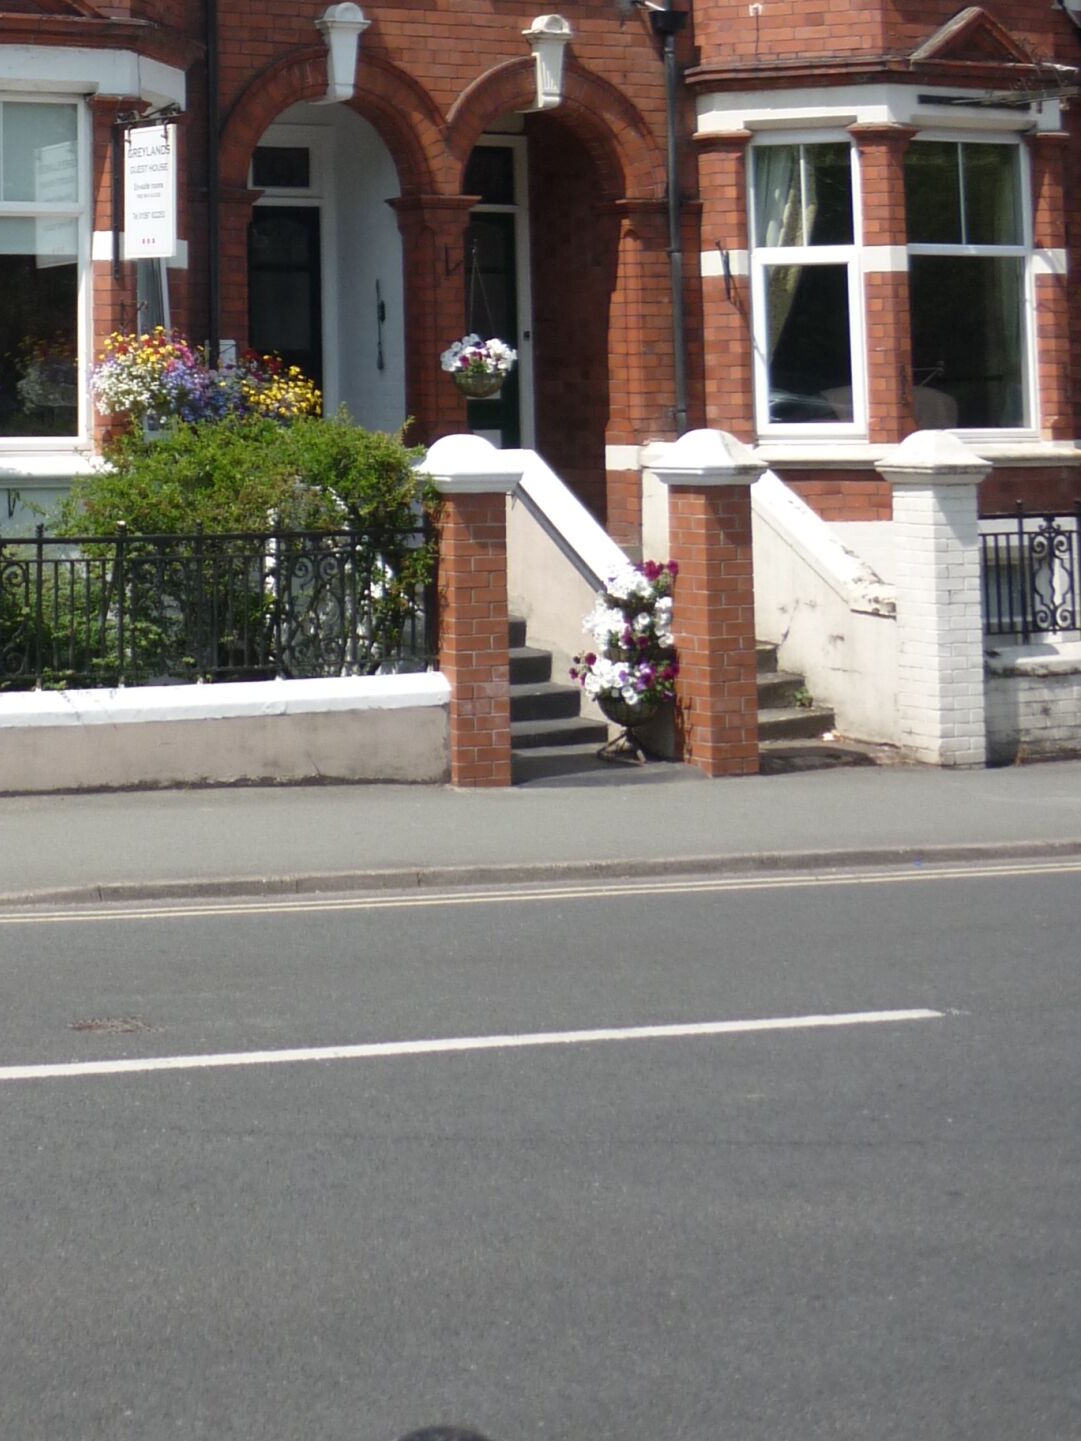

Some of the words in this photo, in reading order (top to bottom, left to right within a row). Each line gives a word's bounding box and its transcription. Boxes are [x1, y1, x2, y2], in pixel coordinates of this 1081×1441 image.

[127, 144, 170, 158] GREYLANDS
[130, 164, 148, 175] GUEST
[149, 162, 169, 172] HOUSE
